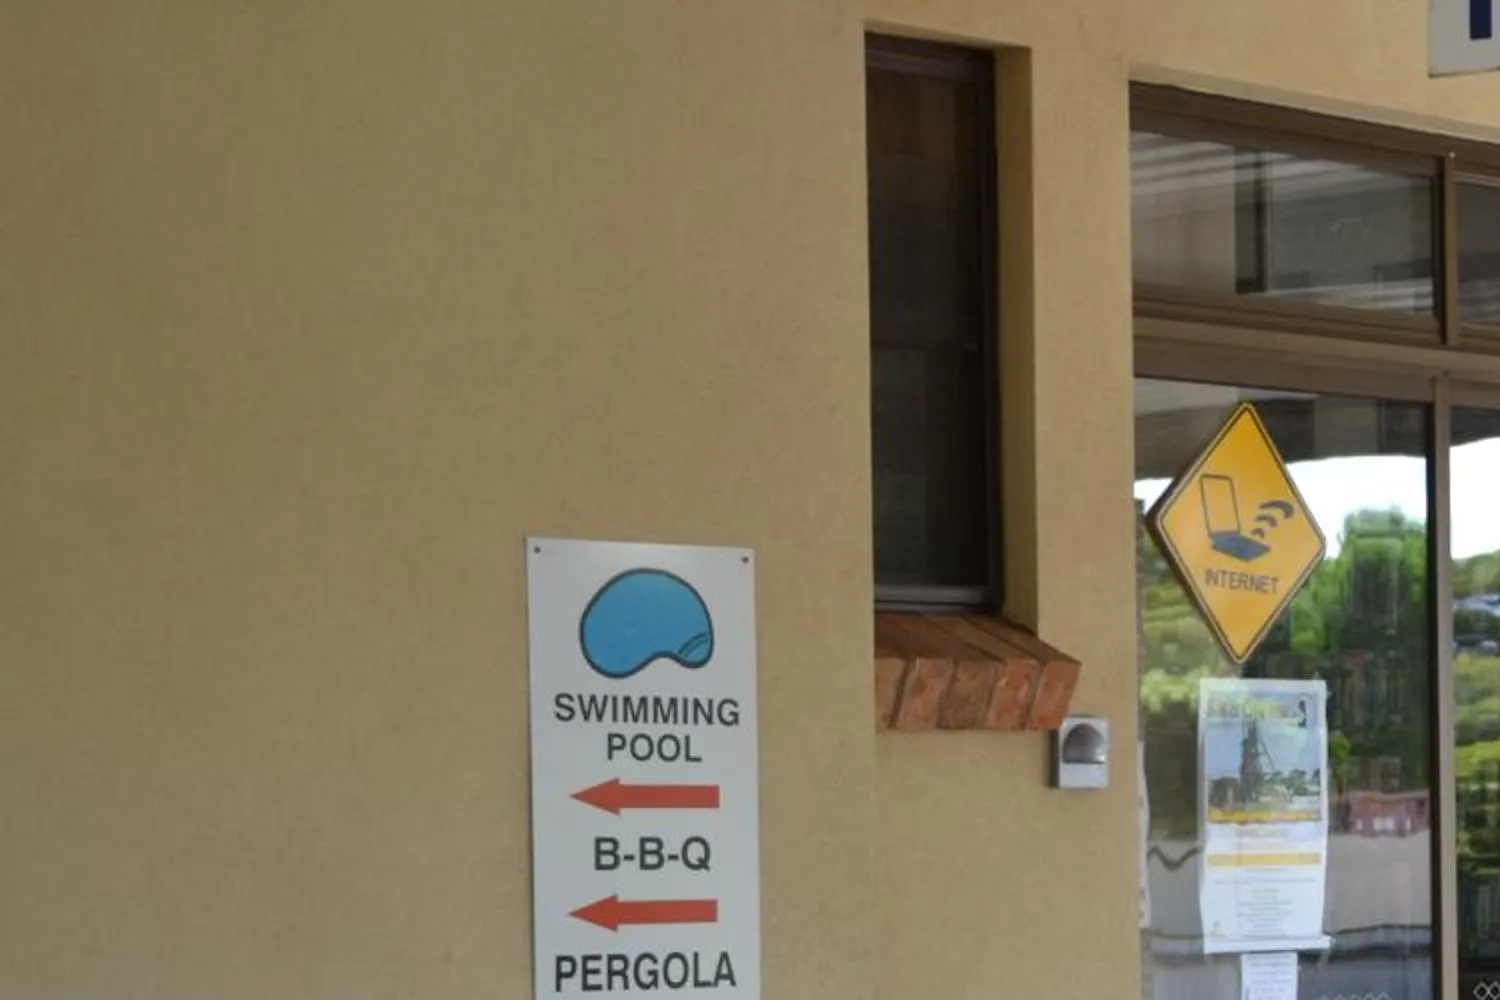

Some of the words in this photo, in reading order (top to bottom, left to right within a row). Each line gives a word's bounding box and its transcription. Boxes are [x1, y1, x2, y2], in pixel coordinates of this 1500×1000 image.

[1204, 567, 1280, 596] INTERNET
[554, 692, 741, 727] SWIMMING
[606, 733, 703, 763] POOL
[593, 836, 712, 872] B-B-Q
[554, 951, 737, 993] PERGOLA
